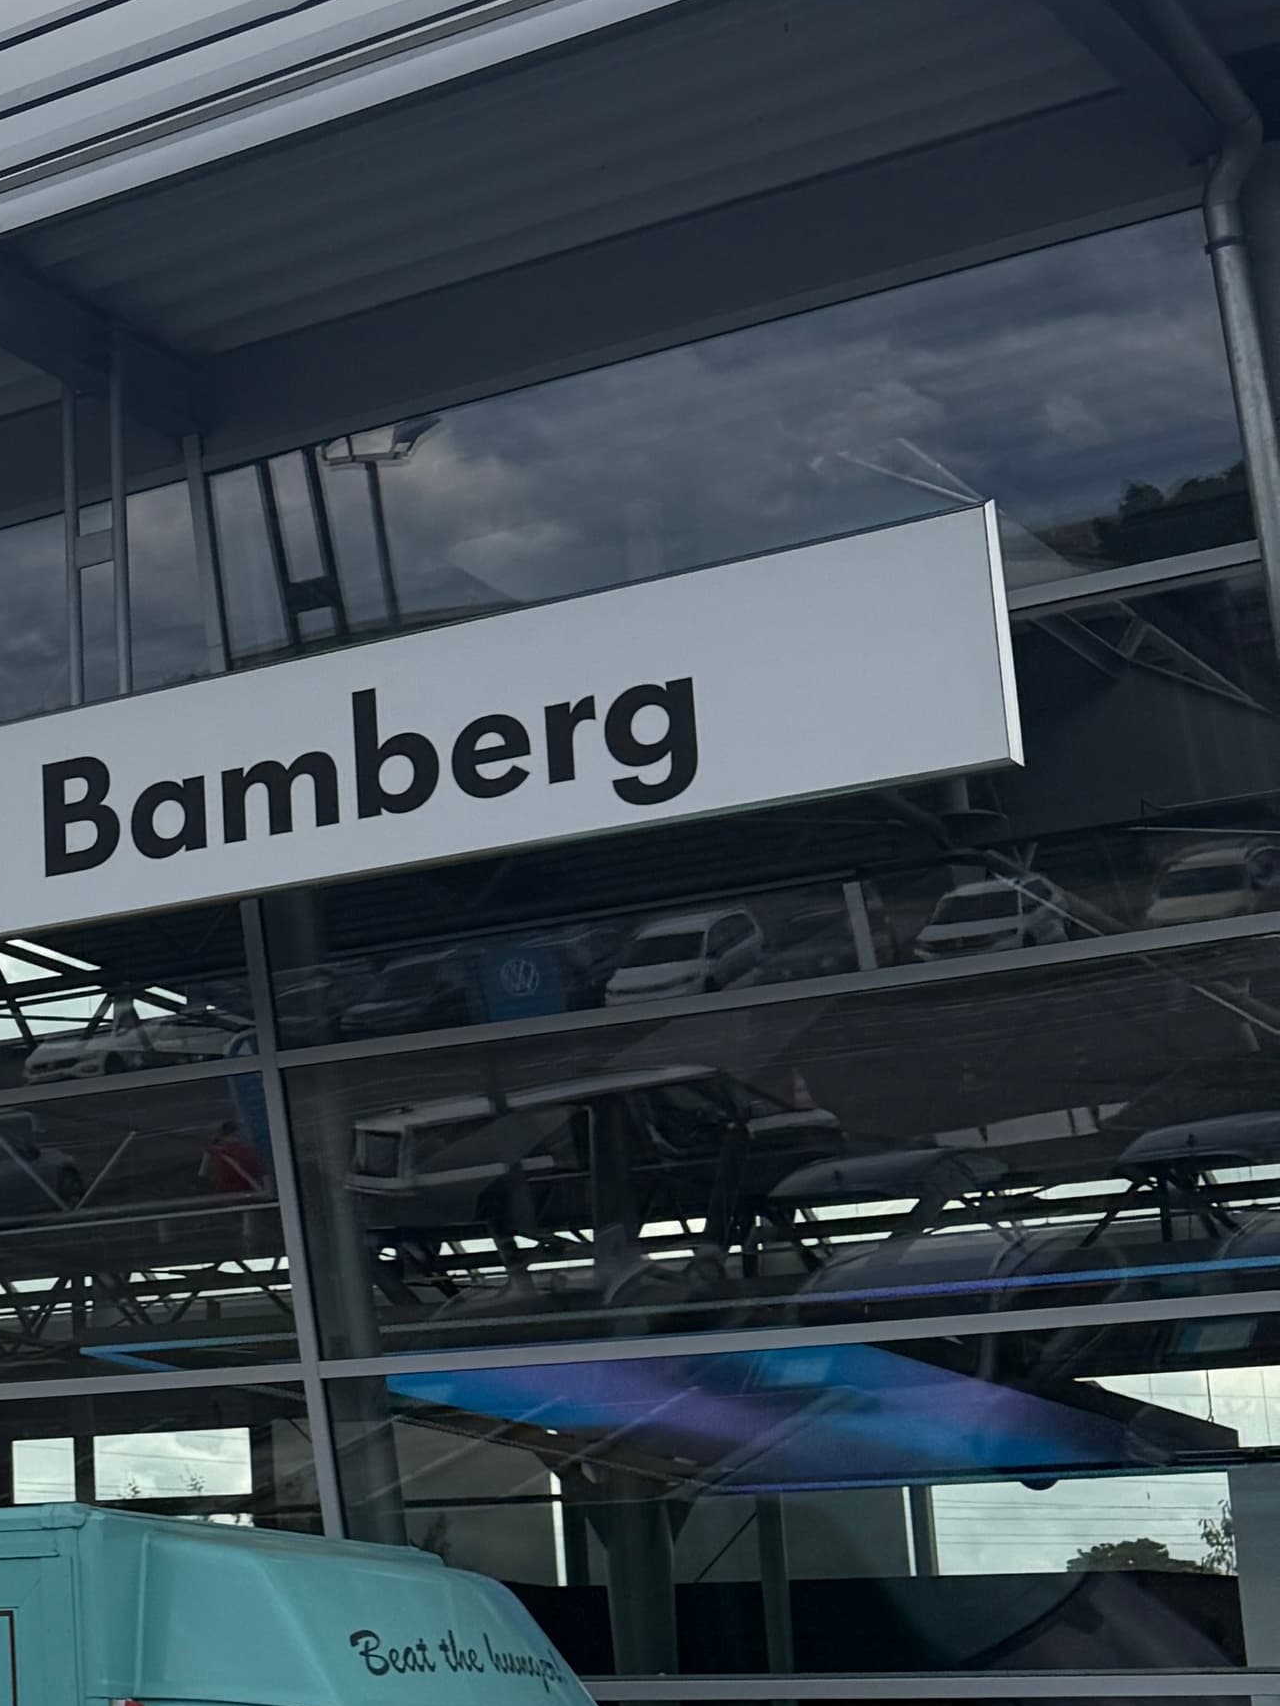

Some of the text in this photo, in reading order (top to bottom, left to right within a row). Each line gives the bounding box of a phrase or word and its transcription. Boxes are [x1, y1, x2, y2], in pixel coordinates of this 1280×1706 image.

[41, 677, 698, 877] Bamberg
[349, 1629, 436, 1676] Beat
[439, 1629, 484, 1673] the
